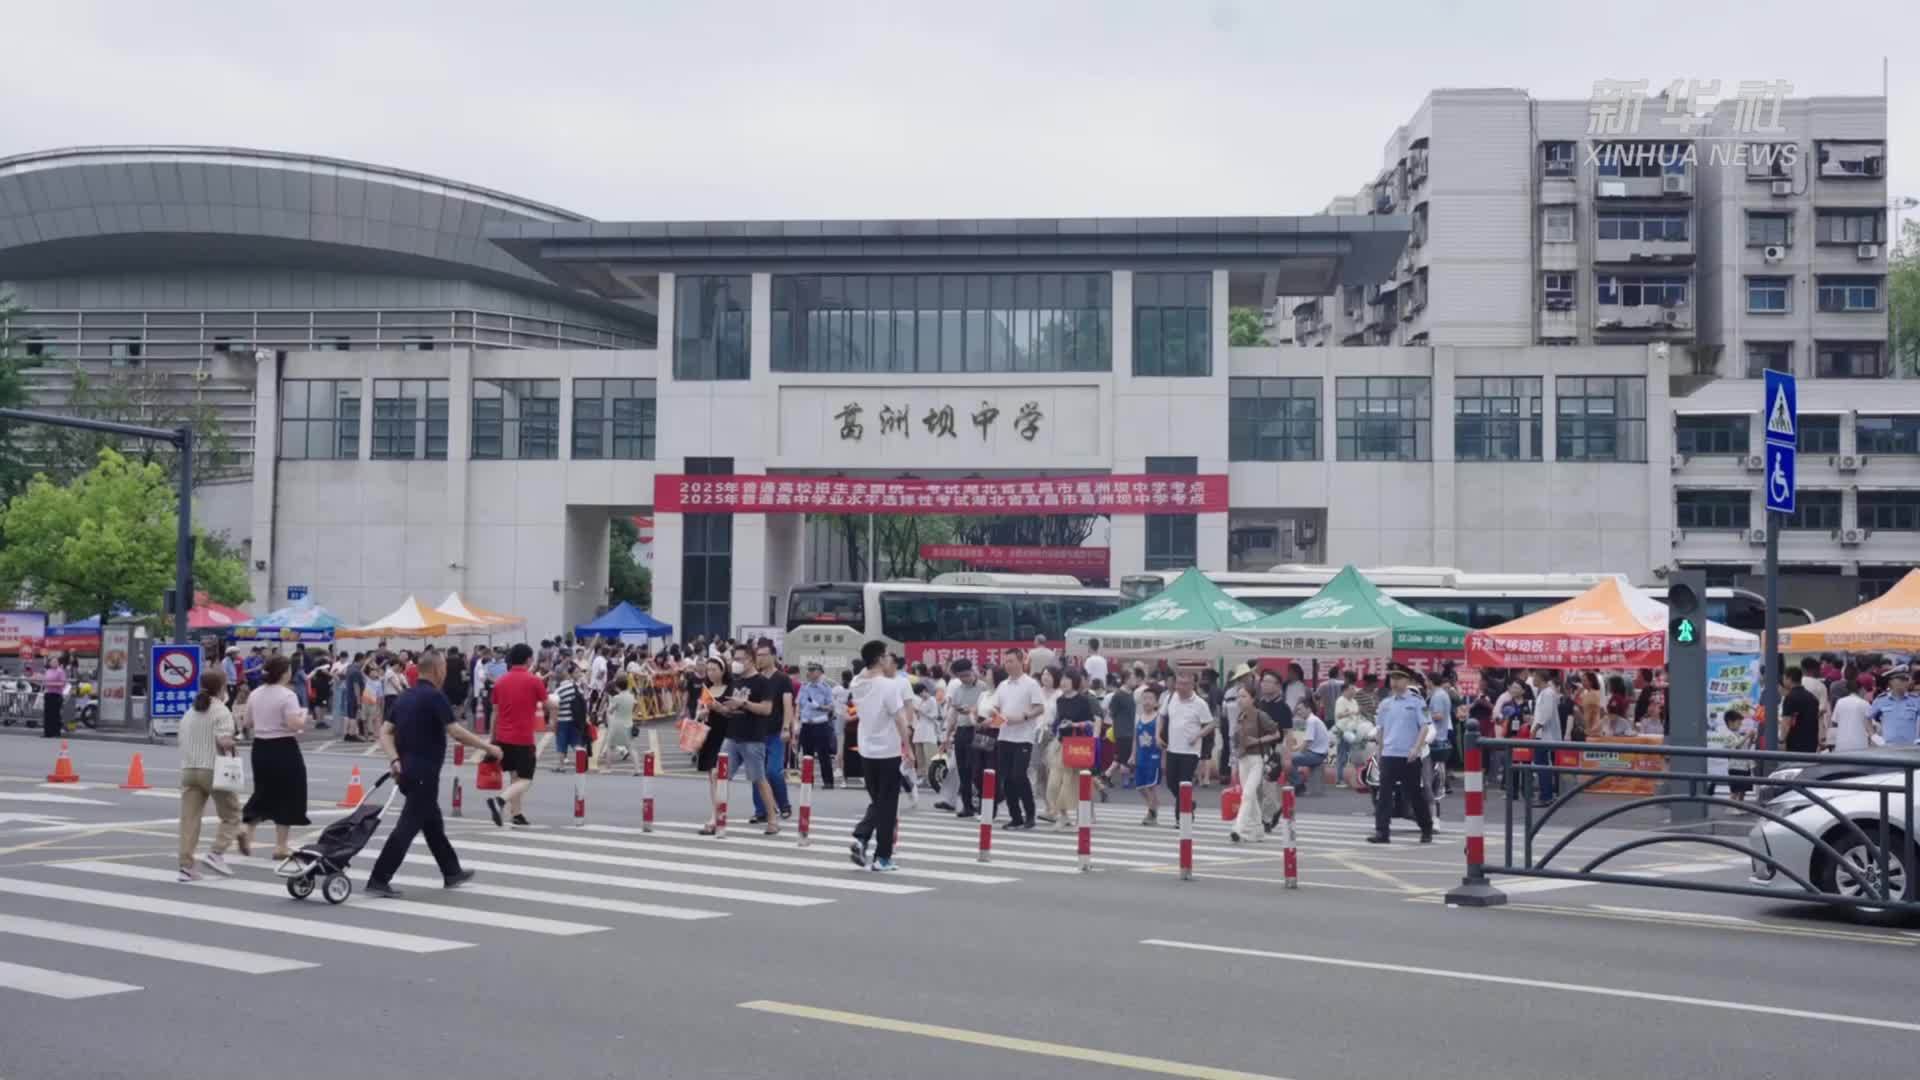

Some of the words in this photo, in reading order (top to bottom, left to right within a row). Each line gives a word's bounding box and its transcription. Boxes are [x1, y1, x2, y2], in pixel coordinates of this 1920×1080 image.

[834, 400, 1044, 442] 葛洲坝中学
[155, 703, 192, 713] 禁止鸣
